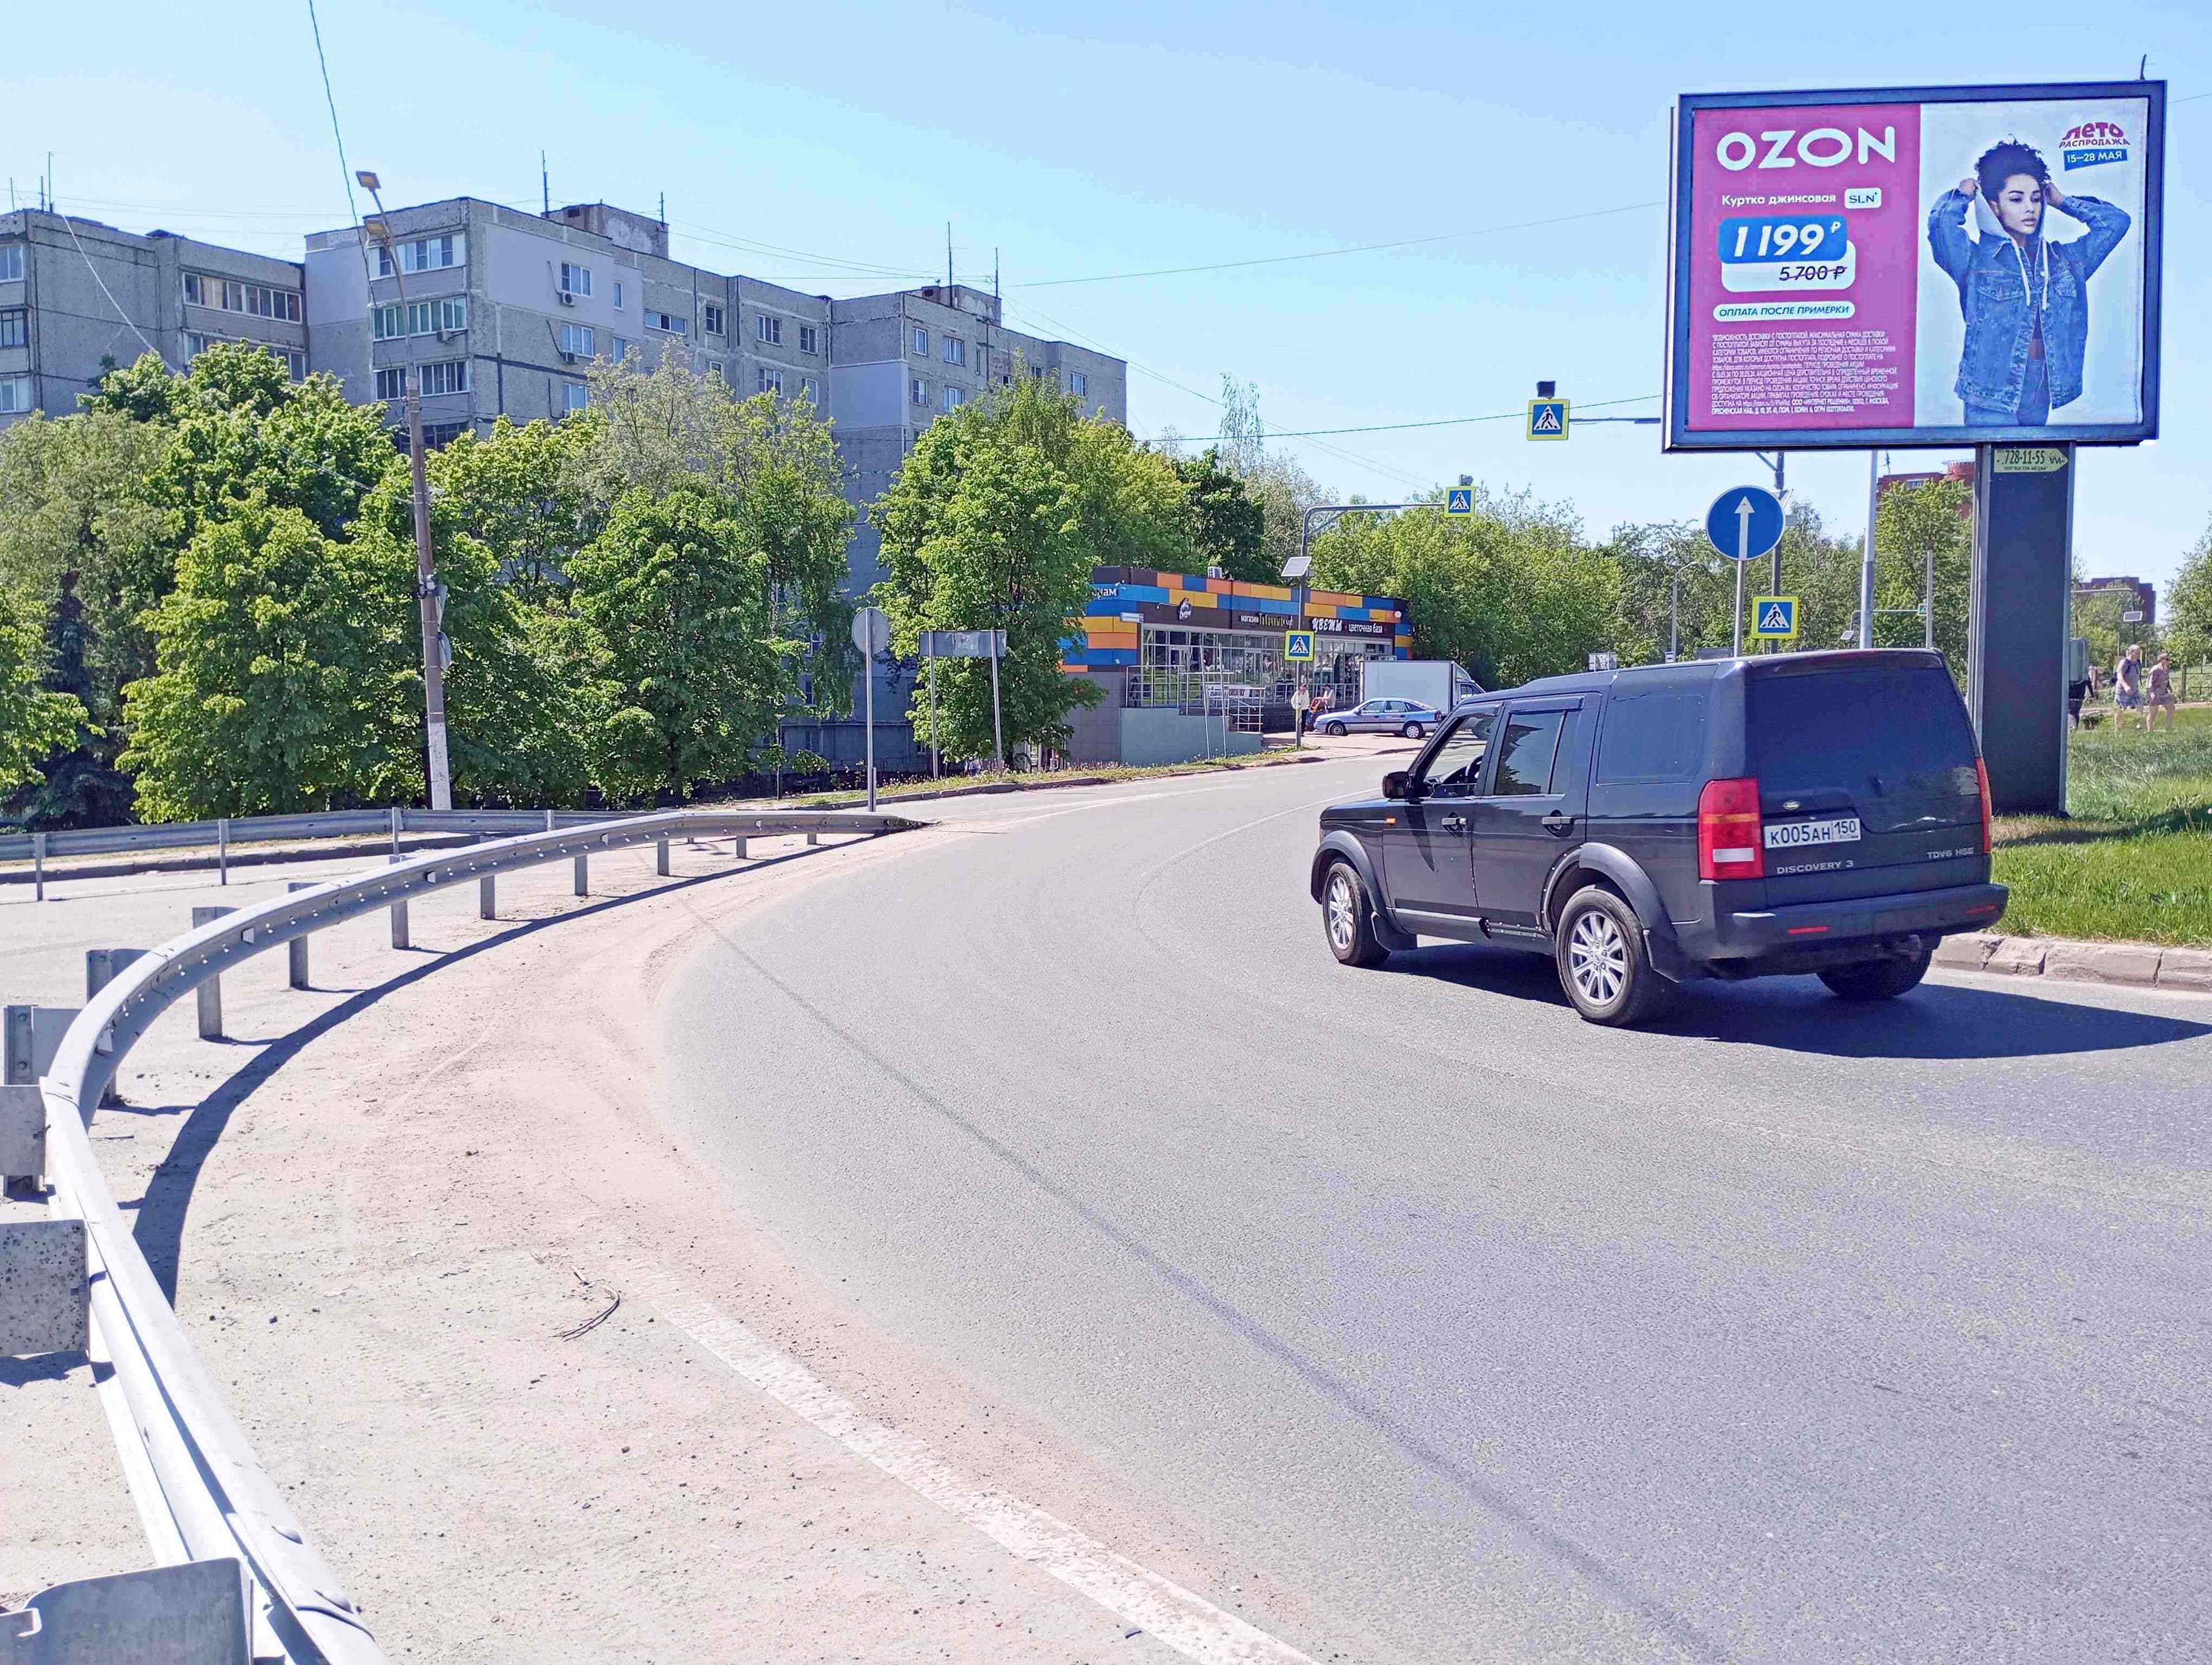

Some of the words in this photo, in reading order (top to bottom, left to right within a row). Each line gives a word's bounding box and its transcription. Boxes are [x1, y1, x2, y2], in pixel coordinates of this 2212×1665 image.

[1717, 126, 1895, 170] OZON
[2059, 138, 2130, 149] РАСПРОДАЖА
[2098, 151, 2122, 161] МАЯ
[1722, 195, 1765, 207] Куртка
[1768, 194, 1836, 205] джинсовая
[1849, 194, 1876, 203] SLN
[1719, 307, 1758, 317] ОПЛАТА
[1760, 306, 1795, 316] ПОСЛЕ
[1797, 305, 1849, 314] ПРИМЕРКИ
[2005, 450, 2045, 465] 728-11-55
[1240, 614, 1259, 623] магазин
[1349, 623, 1372, 632] цветочная
[1373, 623, 1382, 634] база
[1926, 849, 1953, 859] TDV6
[1955, 847, 1974, 856] HSE
[1777, 861, 1842, 874] DISCOVERY
